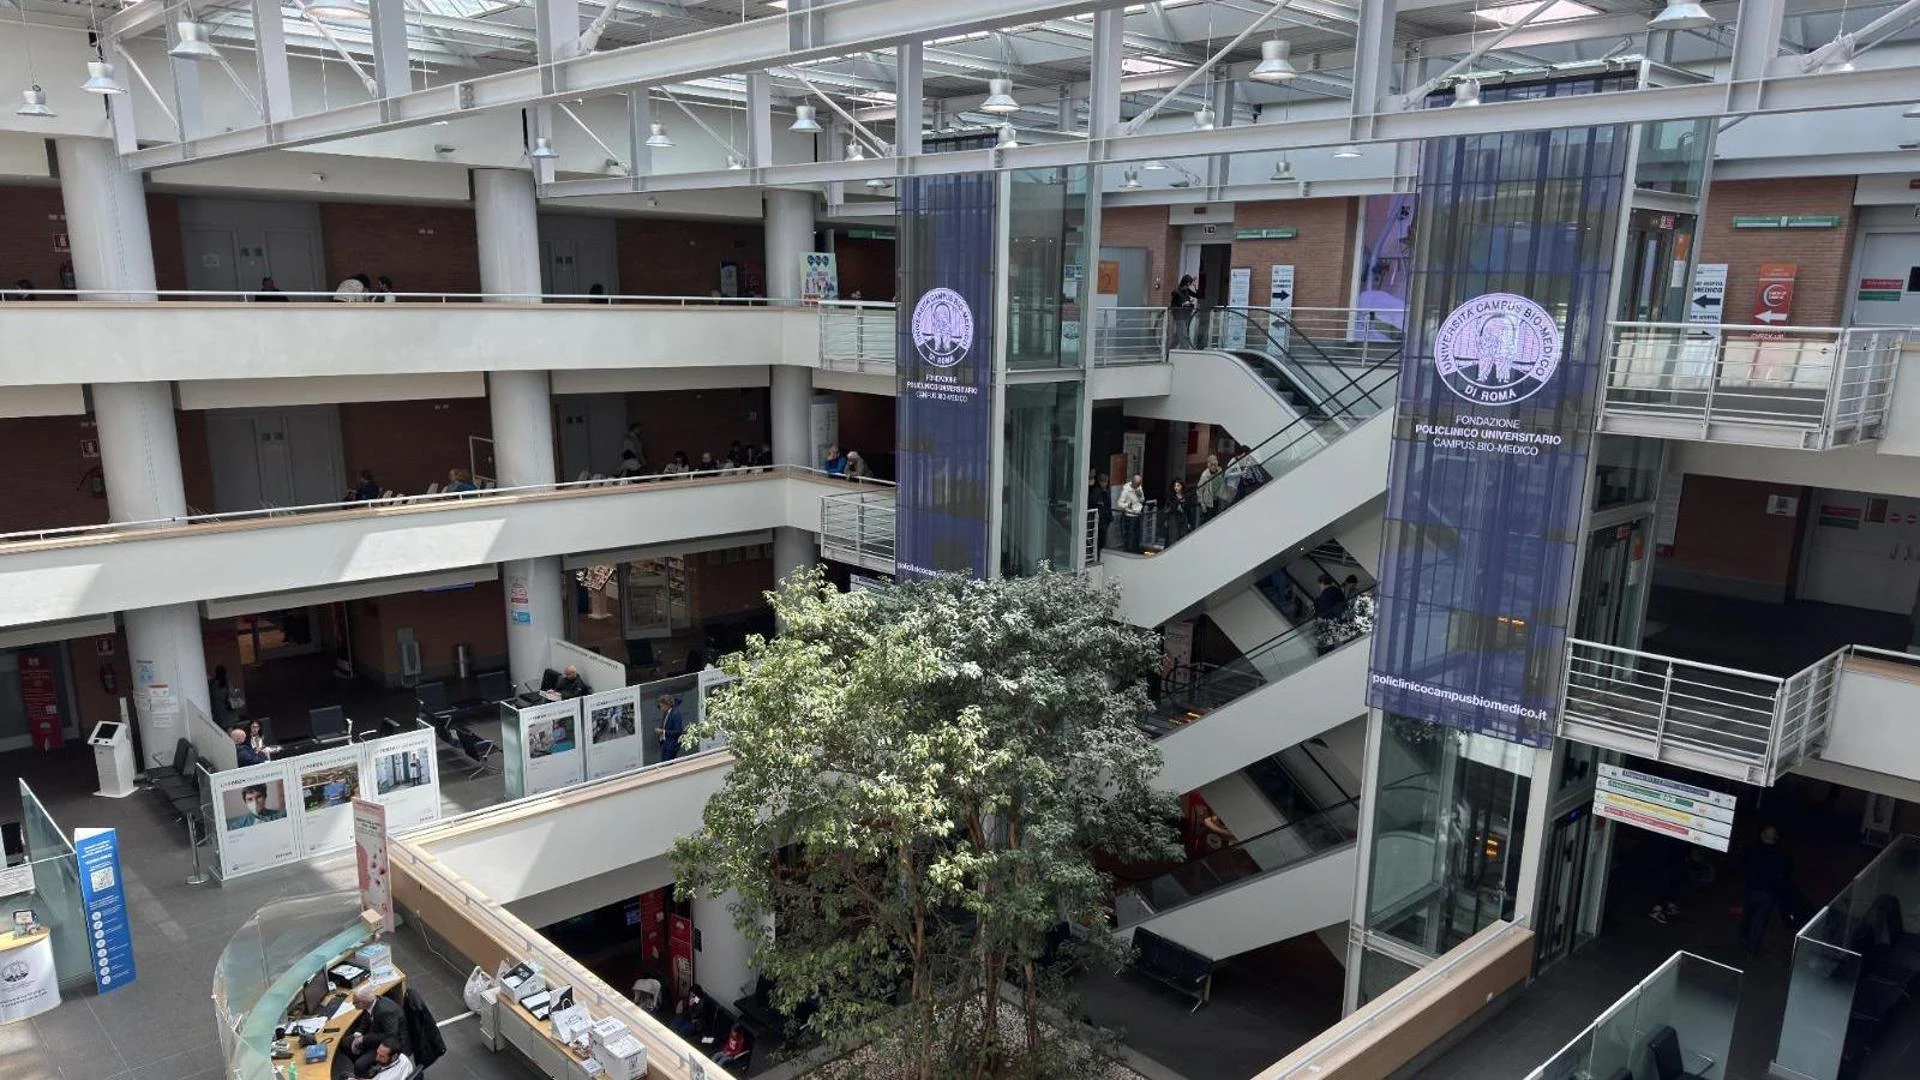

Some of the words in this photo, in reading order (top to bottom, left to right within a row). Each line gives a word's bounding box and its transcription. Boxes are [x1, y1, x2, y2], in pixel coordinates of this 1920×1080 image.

[1476, 299, 1523, 314] CAMPUS
[1523, 307, 1554, 377] BIO-MEDICO
[1464, 384, 1477, 397] DI
[1480, 388, 1518, 402] ROMA
[1455, 414, 1521, 430] FONDAZIONE
[1415, 424, 1479, 438] POLICLINICO
[1480, 428, 1562, 446] UNIVERSITARIO
[1432, 437, 1476, 451] CAMPUS
[1476, 440, 1540, 457] BIO-MEDICO
[1372, 673, 1548, 722] policlinicocampusbiomedico.it
